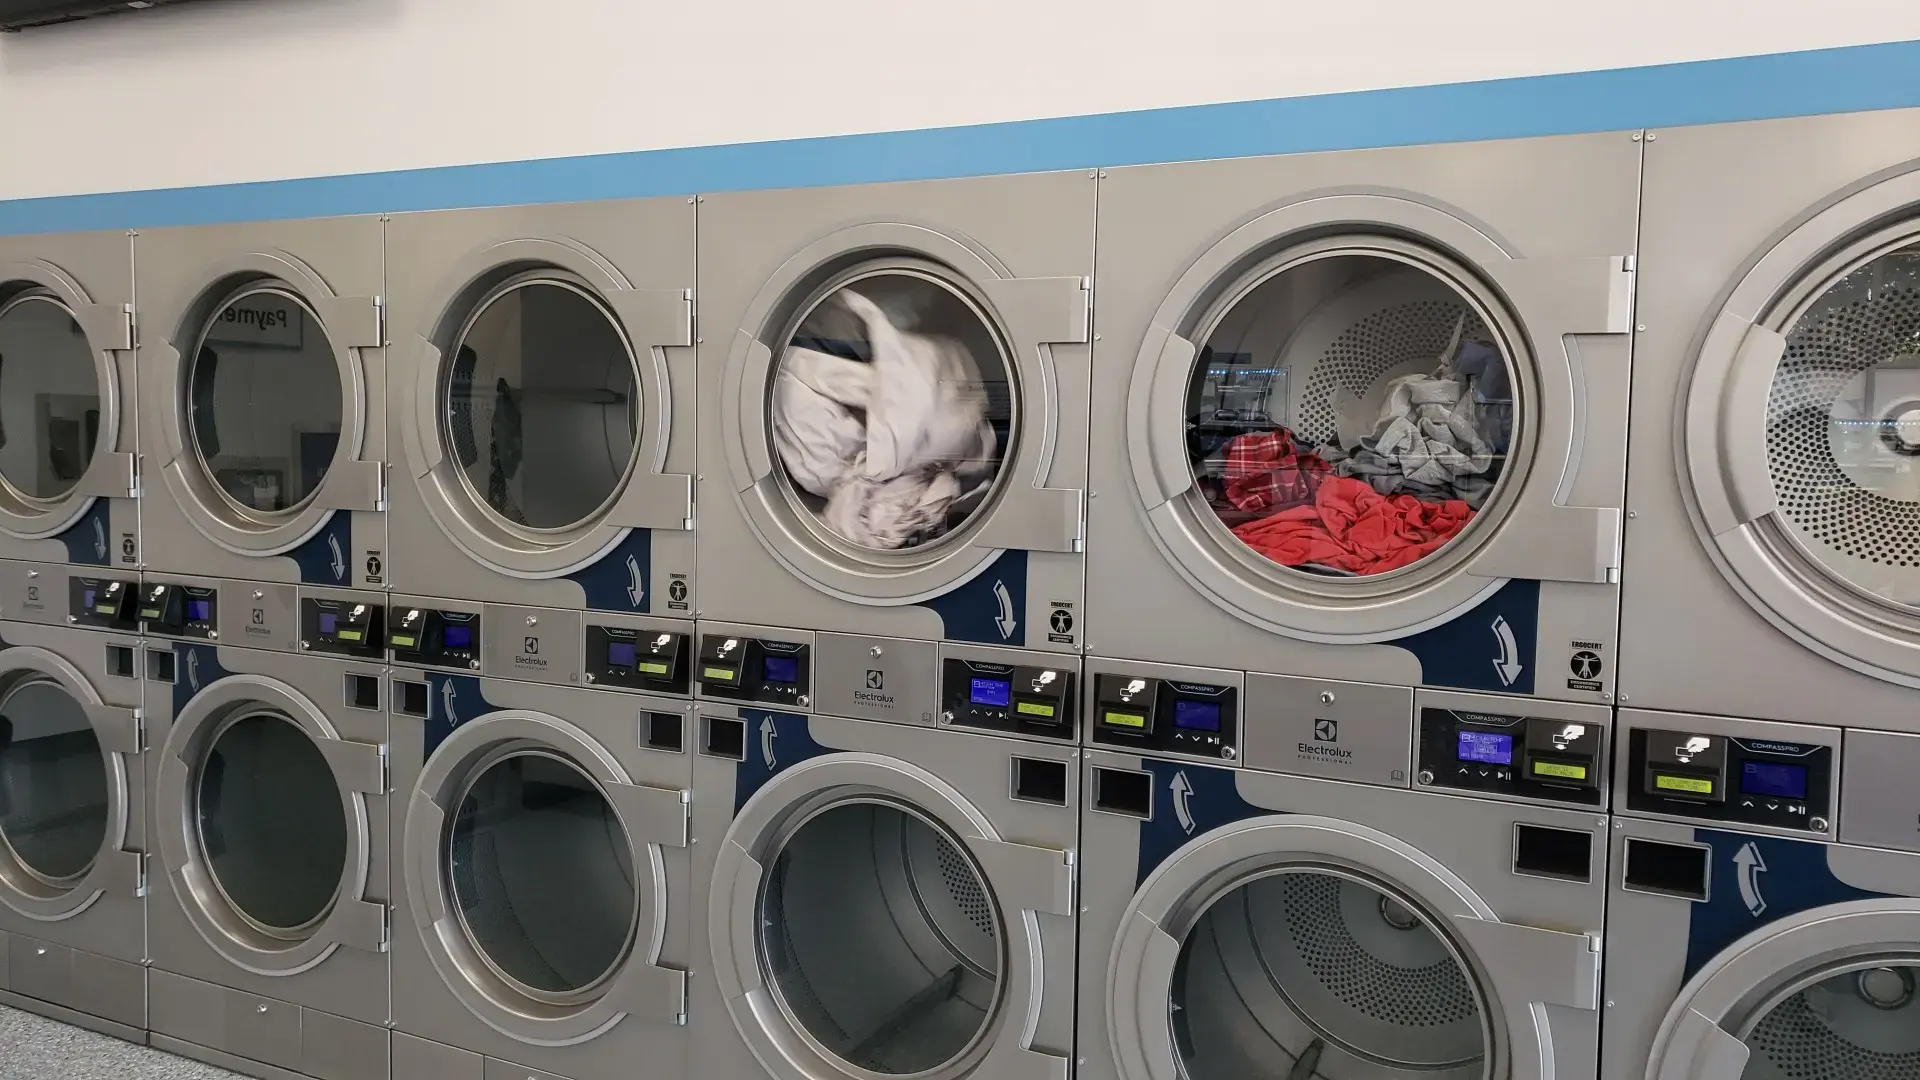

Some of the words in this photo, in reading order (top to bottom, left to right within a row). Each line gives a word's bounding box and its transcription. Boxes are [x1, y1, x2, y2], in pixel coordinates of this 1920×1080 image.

[1571, 641, 1603, 650] ERGOCERT
[854, 690, 895, 703] Electrolux
[1466, 714, 1507, 723] COMPASSPRO
[1298, 742, 1353, 758] Electrolux
[1751, 742, 1800, 753] COMPASSPRO
